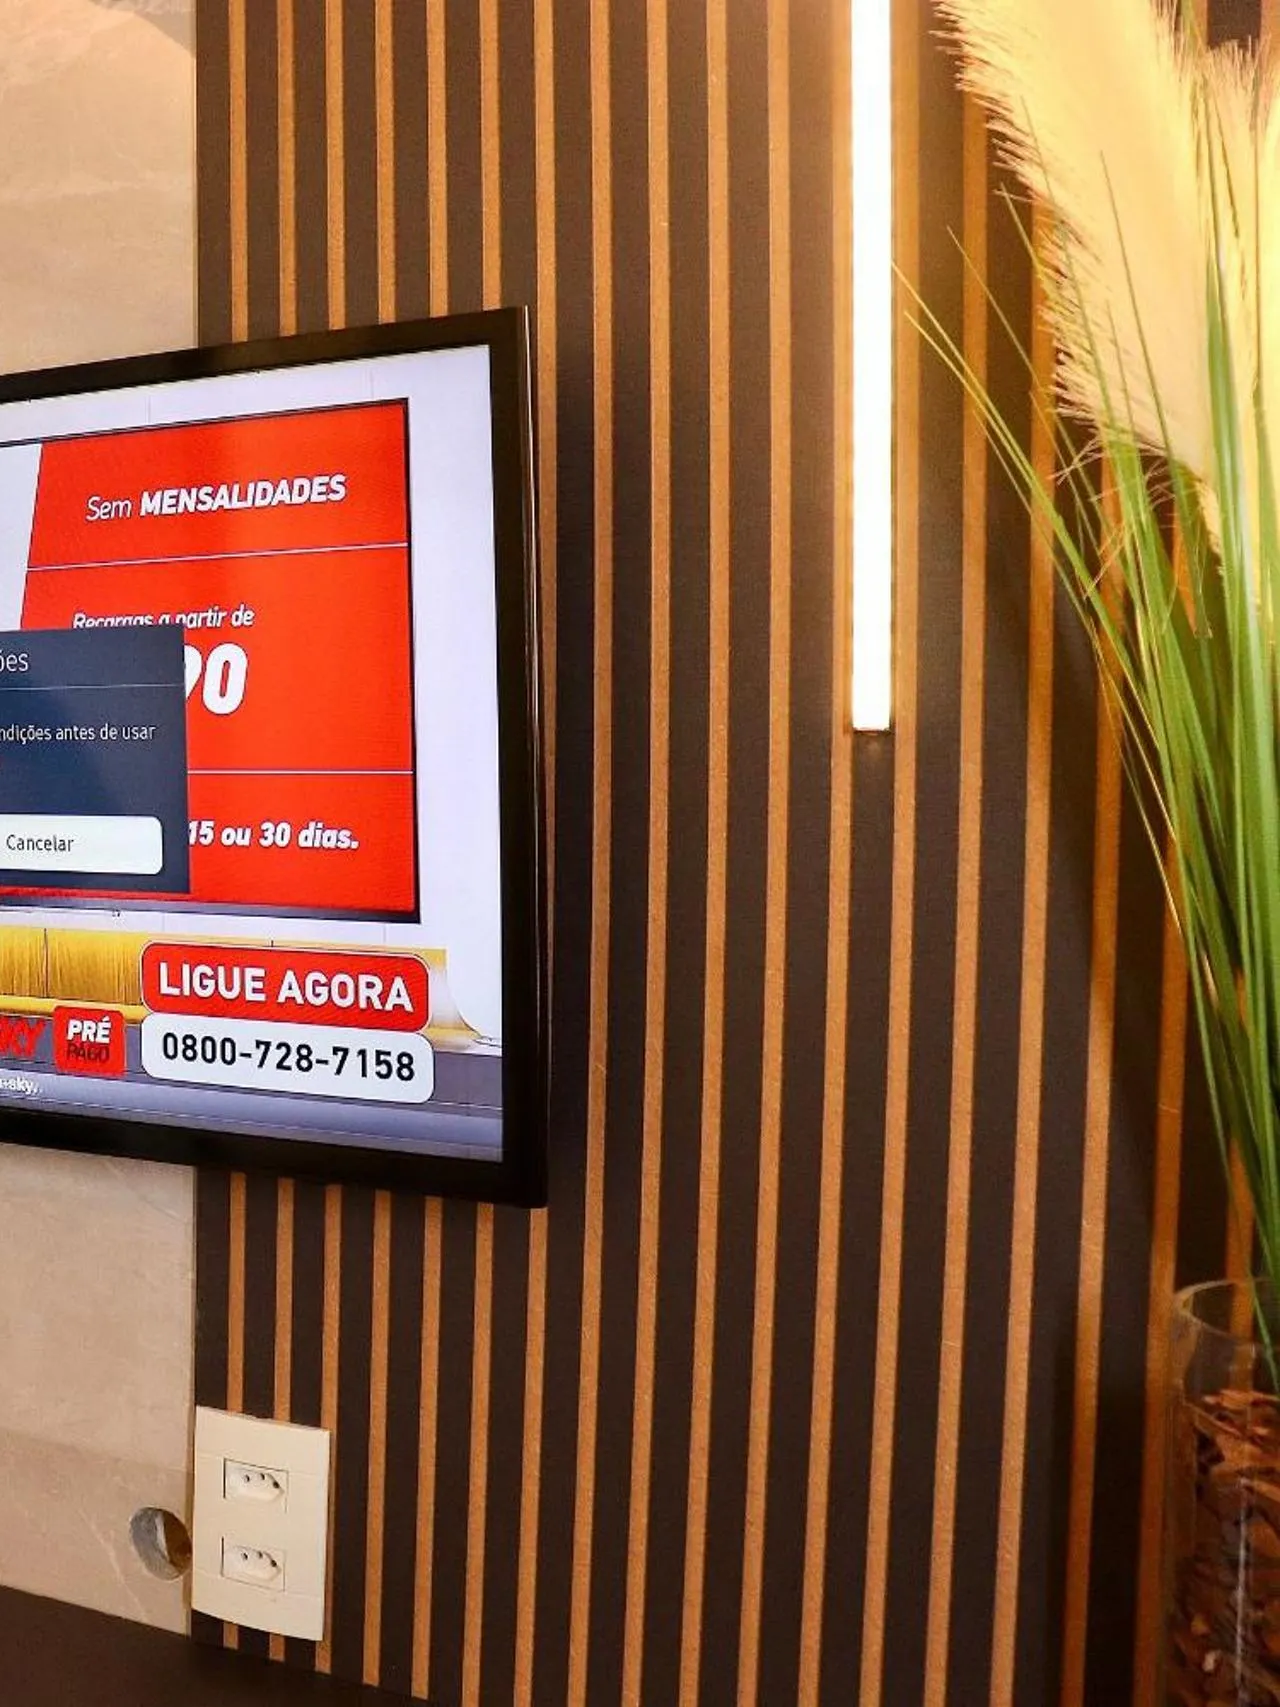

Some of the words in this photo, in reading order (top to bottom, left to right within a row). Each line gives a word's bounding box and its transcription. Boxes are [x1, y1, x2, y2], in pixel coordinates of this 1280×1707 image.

[86, 495, 132, 522] Sem
[139, 473, 347, 517] MENSALIDADES
[231, 604, 255, 627] de
[55, 724, 96, 740] antes
[100, 723, 118, 740] de
[122, 725, 156, 740] usar
[6, 834, 75, 853] Cancelar
[188, 820, 214, 846] 15
[221, 827, 251, 847] ou
[259, 821, 291, 848] 30
[297, 821, 360, 850] dias.
[159, 961, 267, 1003] LIGUE
[276, 969, 415, 1013] AGORA
[66, 1016, 112, 1043] PRÉ
[66, 1042, 110, 1063] PAGO
[162, 1032, 416, 1083] 0800-728-7158
